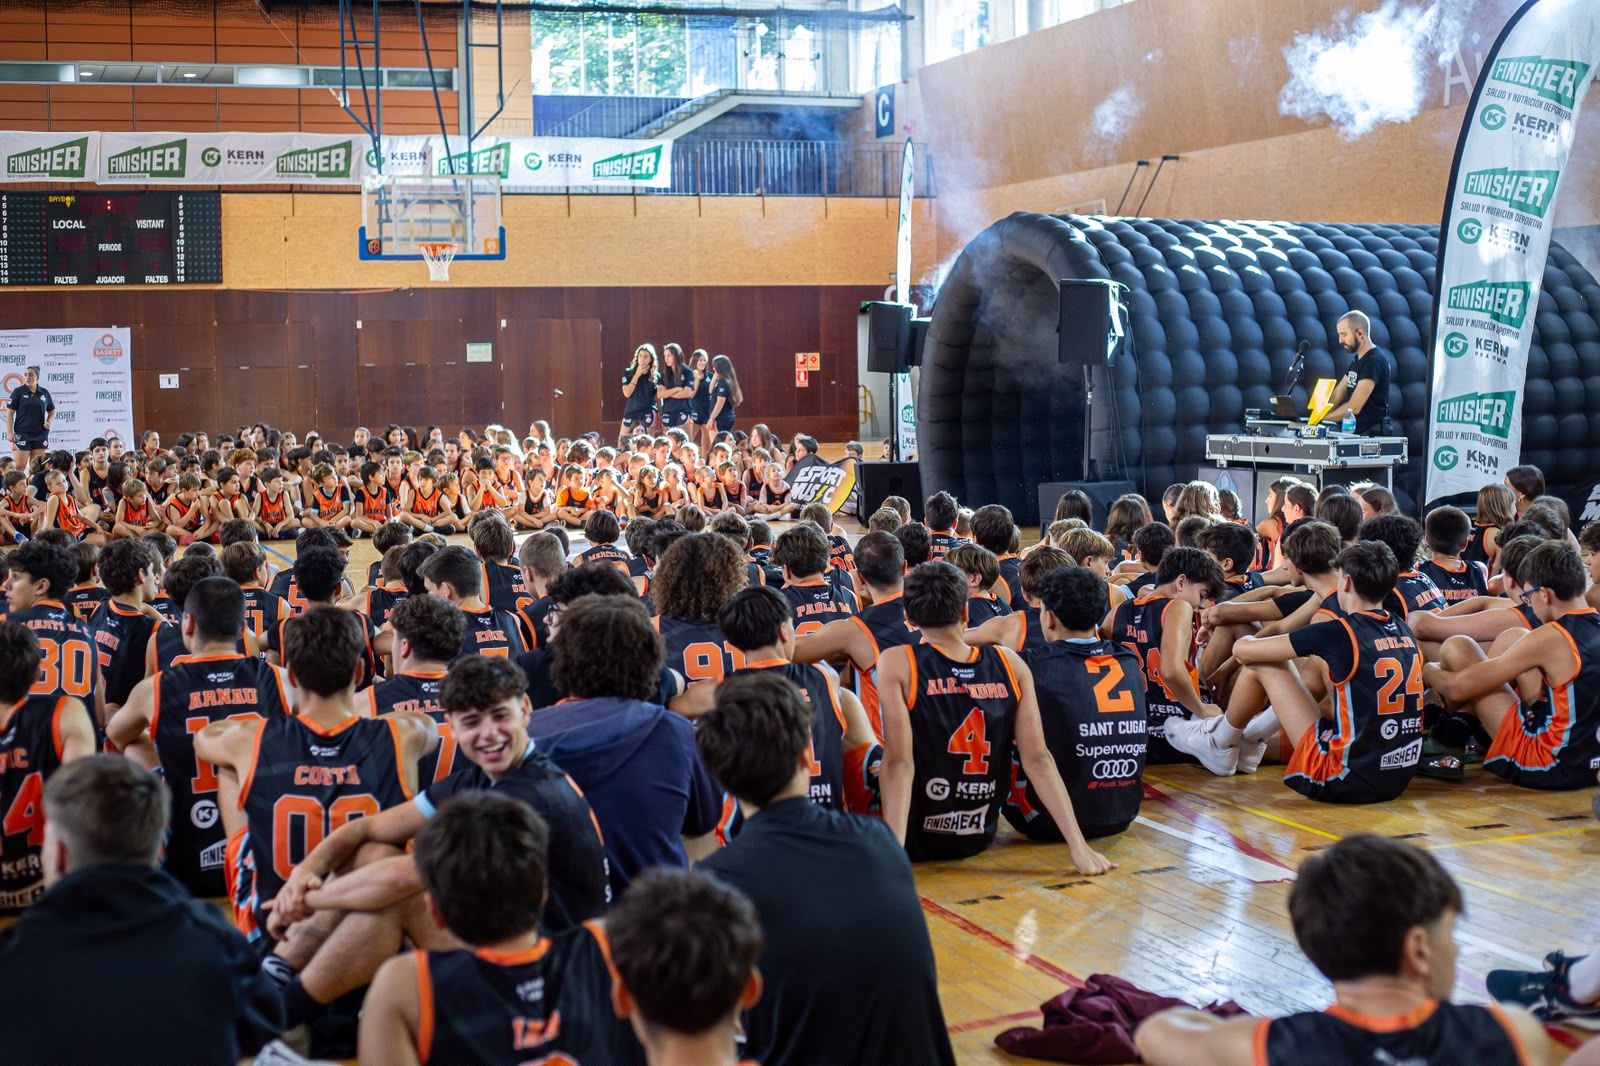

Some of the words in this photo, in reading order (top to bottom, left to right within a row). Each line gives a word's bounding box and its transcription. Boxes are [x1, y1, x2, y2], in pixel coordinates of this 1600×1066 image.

[1494, 60, 1577, 98] FINISHER
[878, 92, 890, 128] C
[1486, 87, 1507, 99] SALUD
[1507, 91, 1513, 101] Y
[1512, 93, 1544, 110] NUTRICIÓN
[1543, 102, 1572, 121] DEPORTIVA
[1513, 112, 1560, 136] KERN
[9, 145, 82, 172] FINISHER
[110, 146, 181, 173] FINISHER
[227, 149, 265, 160] KERN
[278, 147, 346, 172] FINISHER
[390, 151, 427, 161] KERN
[548, 153, 582, 164] KERN
[594, 151, 656, 177] FINISHER
[1466, 173, 1550, 209] FINISHER
[52, 220, 86, 229] LOCAL
[136, 220, 165, 229] VISITANT
[1460, 201, 1481, 213] SALUD
[1480, 204, 1486, 215] Y
[1485, 206, 1515, 221] NUTRICIÓN
[1514, 213, 1544, 231] DEPORTIVA
[1489, 223, 1531, 248] KERN
[98, 243, 122, 252] PERIODE
[54, 276, 78, 284] FALTES
[95, 276, 125, 284] JUGADOR
[145, 275, 169, 284] FALTES
[176, 275, 185, 283] 15
[1449, 286, 1525, 319] FINISHER
[1445, 316, 1464, 327] SALUD
[1465, 318, 1470, 328] Y
[1470, 320, 1496, 334] NUTRICIÓN
[46, 334, 74, 343] FINISHER
[1475, 336, 1510, 359] KERN
[48, 373, 74, 382] FINISHER
[95, 391, 122, 400] FINISHER
[1435, 430, 1454, 440] SALUD
[1454, 431, 1460, 440] Y
[1466, 449, 1499, 469] KRN
[794, 465, 847, 487] ESPORT
[29, 637, 92, 698] 30
[1084, 654, 1135, 713] 2
[1373, 653, 1424, 716] 24
[188, 687, 258, 711] ARNAU
[1078, 721, 1115, 737] SANT
[1117, 719, 1147, 735] CUGAT
[947, 706, 991, 776] 4
[186, 712, 265, 795] 1
[1382, 743, 1419, 766] FINISHER
[293, 764, 361, 786] COSTA
[811, 783, 832, 797] RN
[955, 778, 996, 795] KERN
[925, 811, 984, 831] FINISHER
